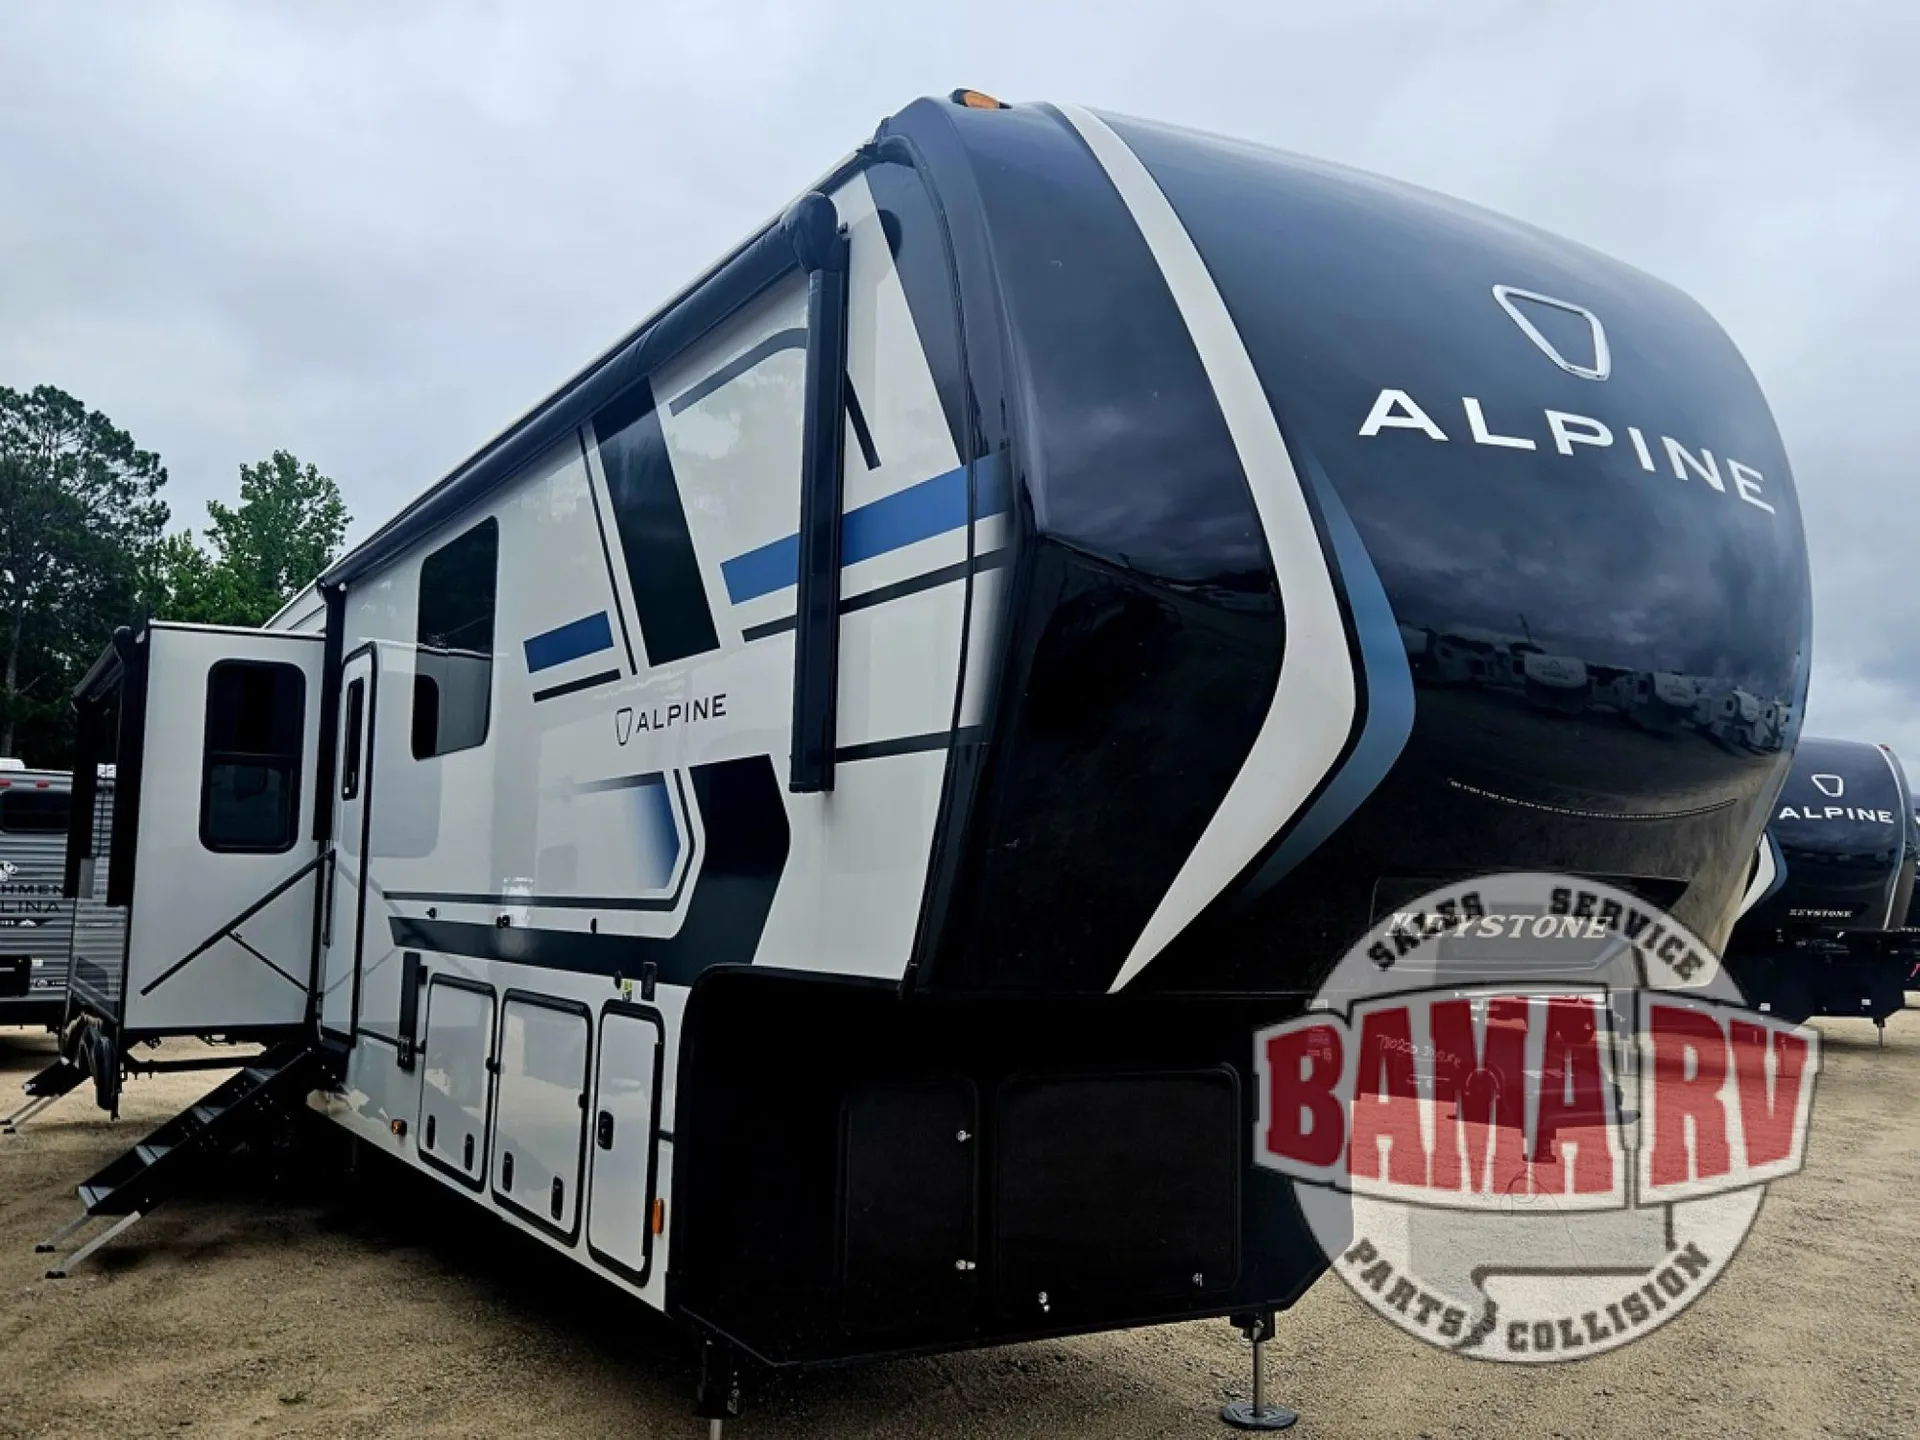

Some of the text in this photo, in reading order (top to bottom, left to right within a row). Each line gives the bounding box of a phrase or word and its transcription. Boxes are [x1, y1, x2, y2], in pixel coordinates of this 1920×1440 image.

[1358, 389, 1776, 514] ALPINE
[636, 693, 727, 733] ALPINE
[1779, 806, 1894, 824] ALPINE
[1385, 913, 1613, 938] KEYSTONE
